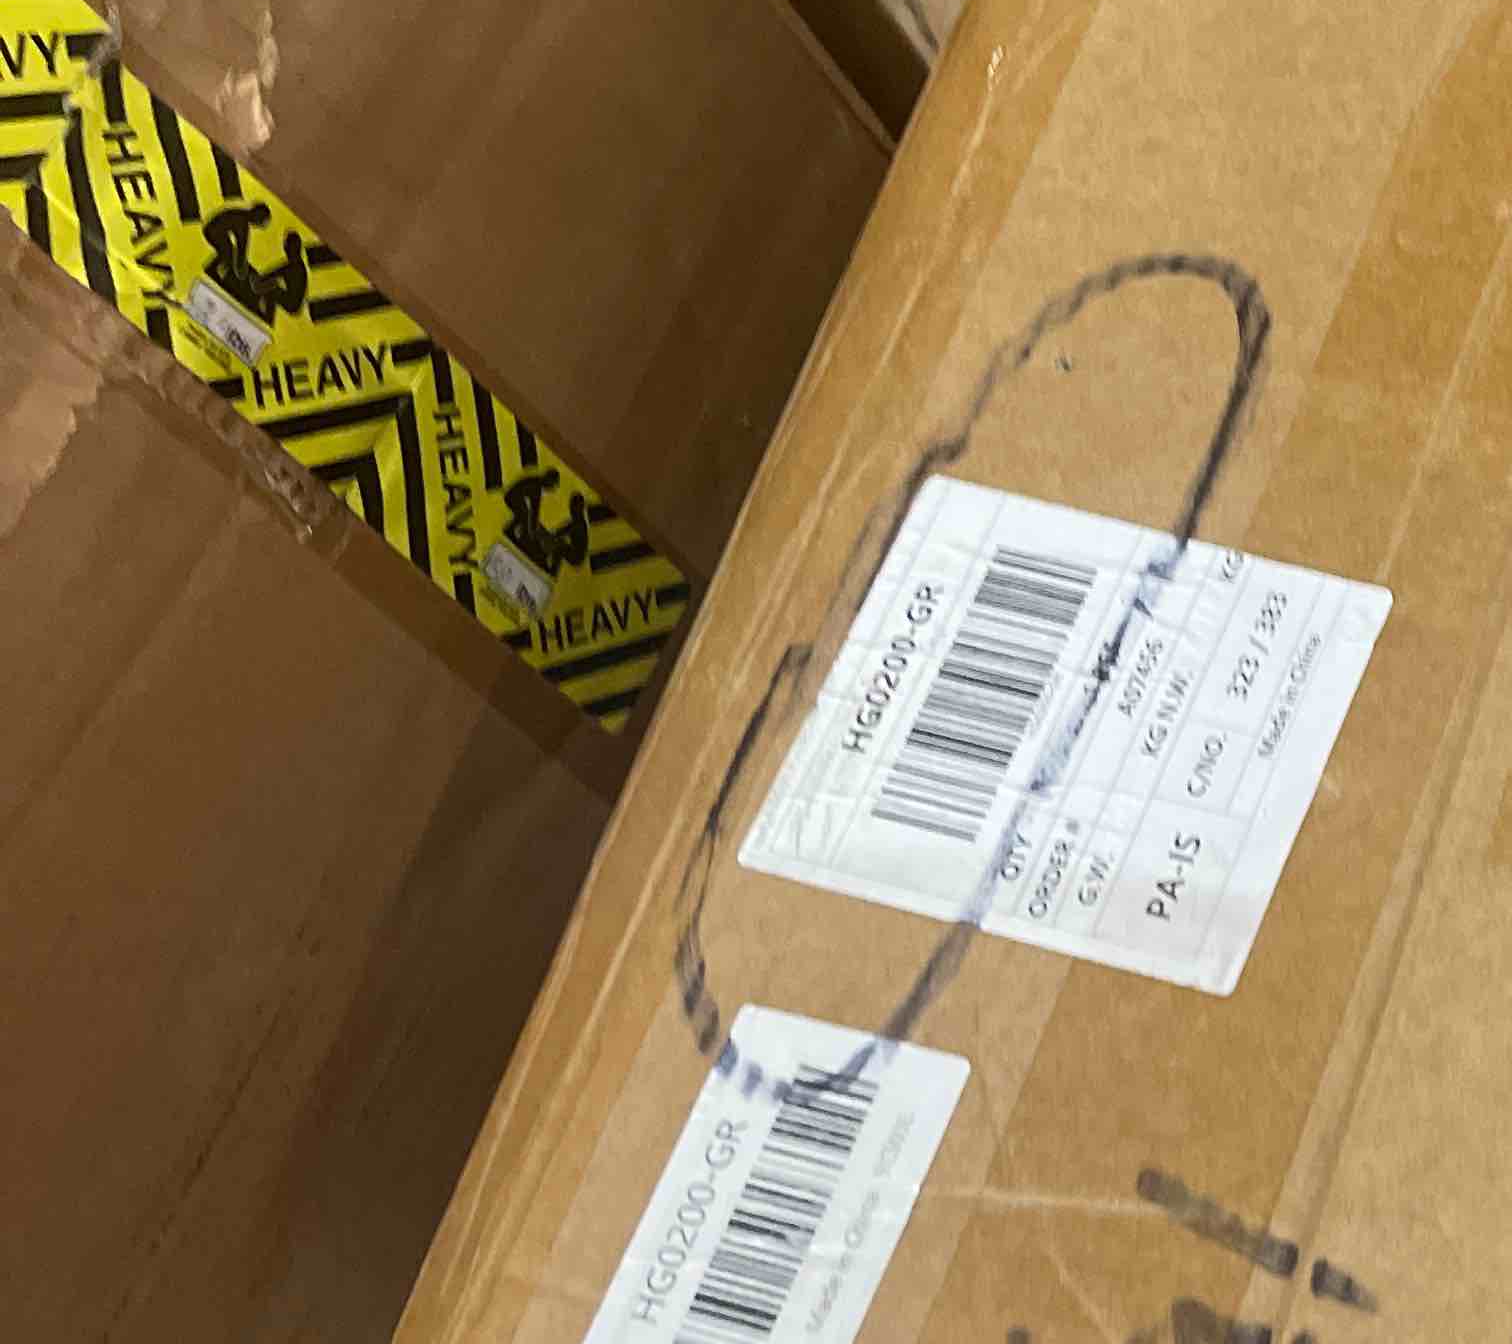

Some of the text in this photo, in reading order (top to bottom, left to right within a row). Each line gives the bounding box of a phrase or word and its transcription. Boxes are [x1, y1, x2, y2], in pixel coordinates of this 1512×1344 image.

[102, 121, 184, 308] HEAVY
[252, 341, 395, 409] HEAVY
[433, 401, 480, 574] HEAVY
[537, 586, 658, 653] HEAVY
[1028, 838, 1075, 919] ORDER
[633, 1118, 748, 1326] HG0200-GR
